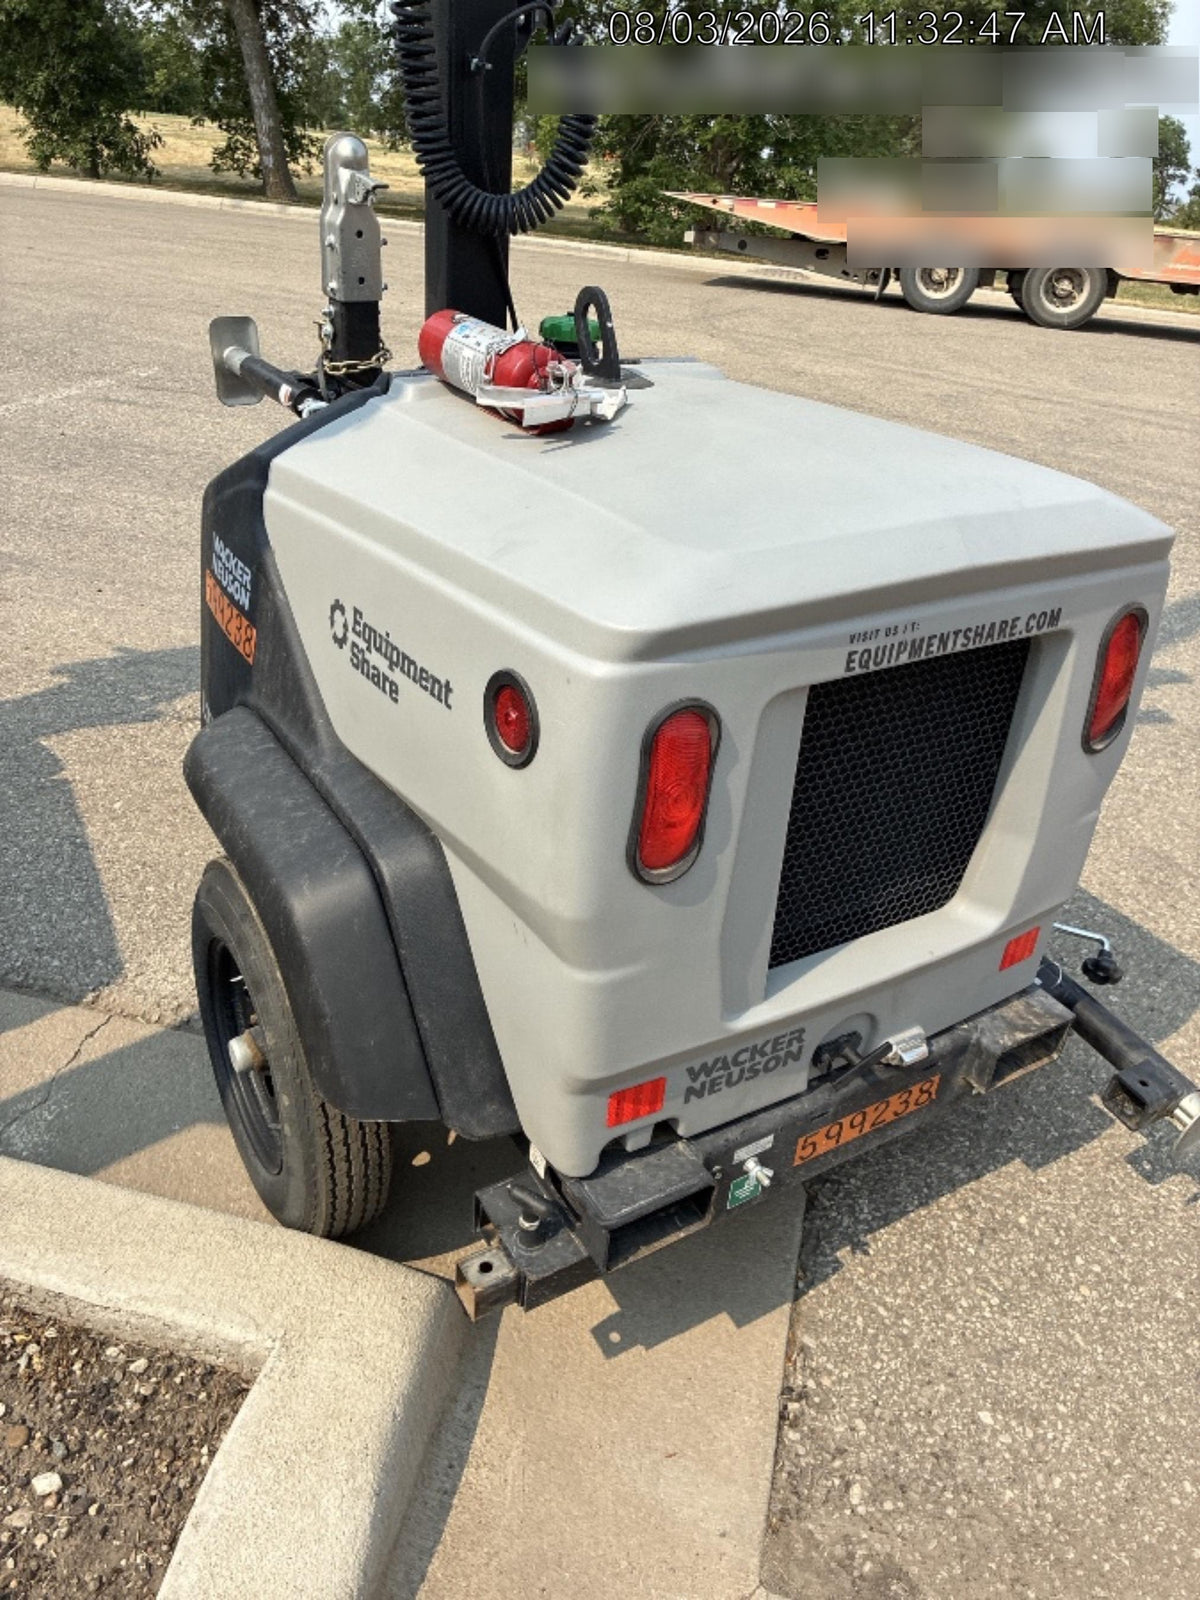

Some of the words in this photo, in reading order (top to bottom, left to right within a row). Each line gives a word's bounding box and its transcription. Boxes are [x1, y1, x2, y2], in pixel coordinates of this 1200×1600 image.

[211, 552, 251, 611] NEUSON
[212, 531, 252, 591] WACKER
[351, 605, 454, 710] Equipment
[844, 607, 1063, 673] EQUIPMENTSHARE.COM
[849, 628, 881, 645] VISIT
[884, 624, 899, 638] US
[349, 640, 399, 704] Share
[684, 1045, 804, 1105] NEUSON
[685, 1027, 806, 1083] WACKER
[797, 1080, 936, 1161] 599238
